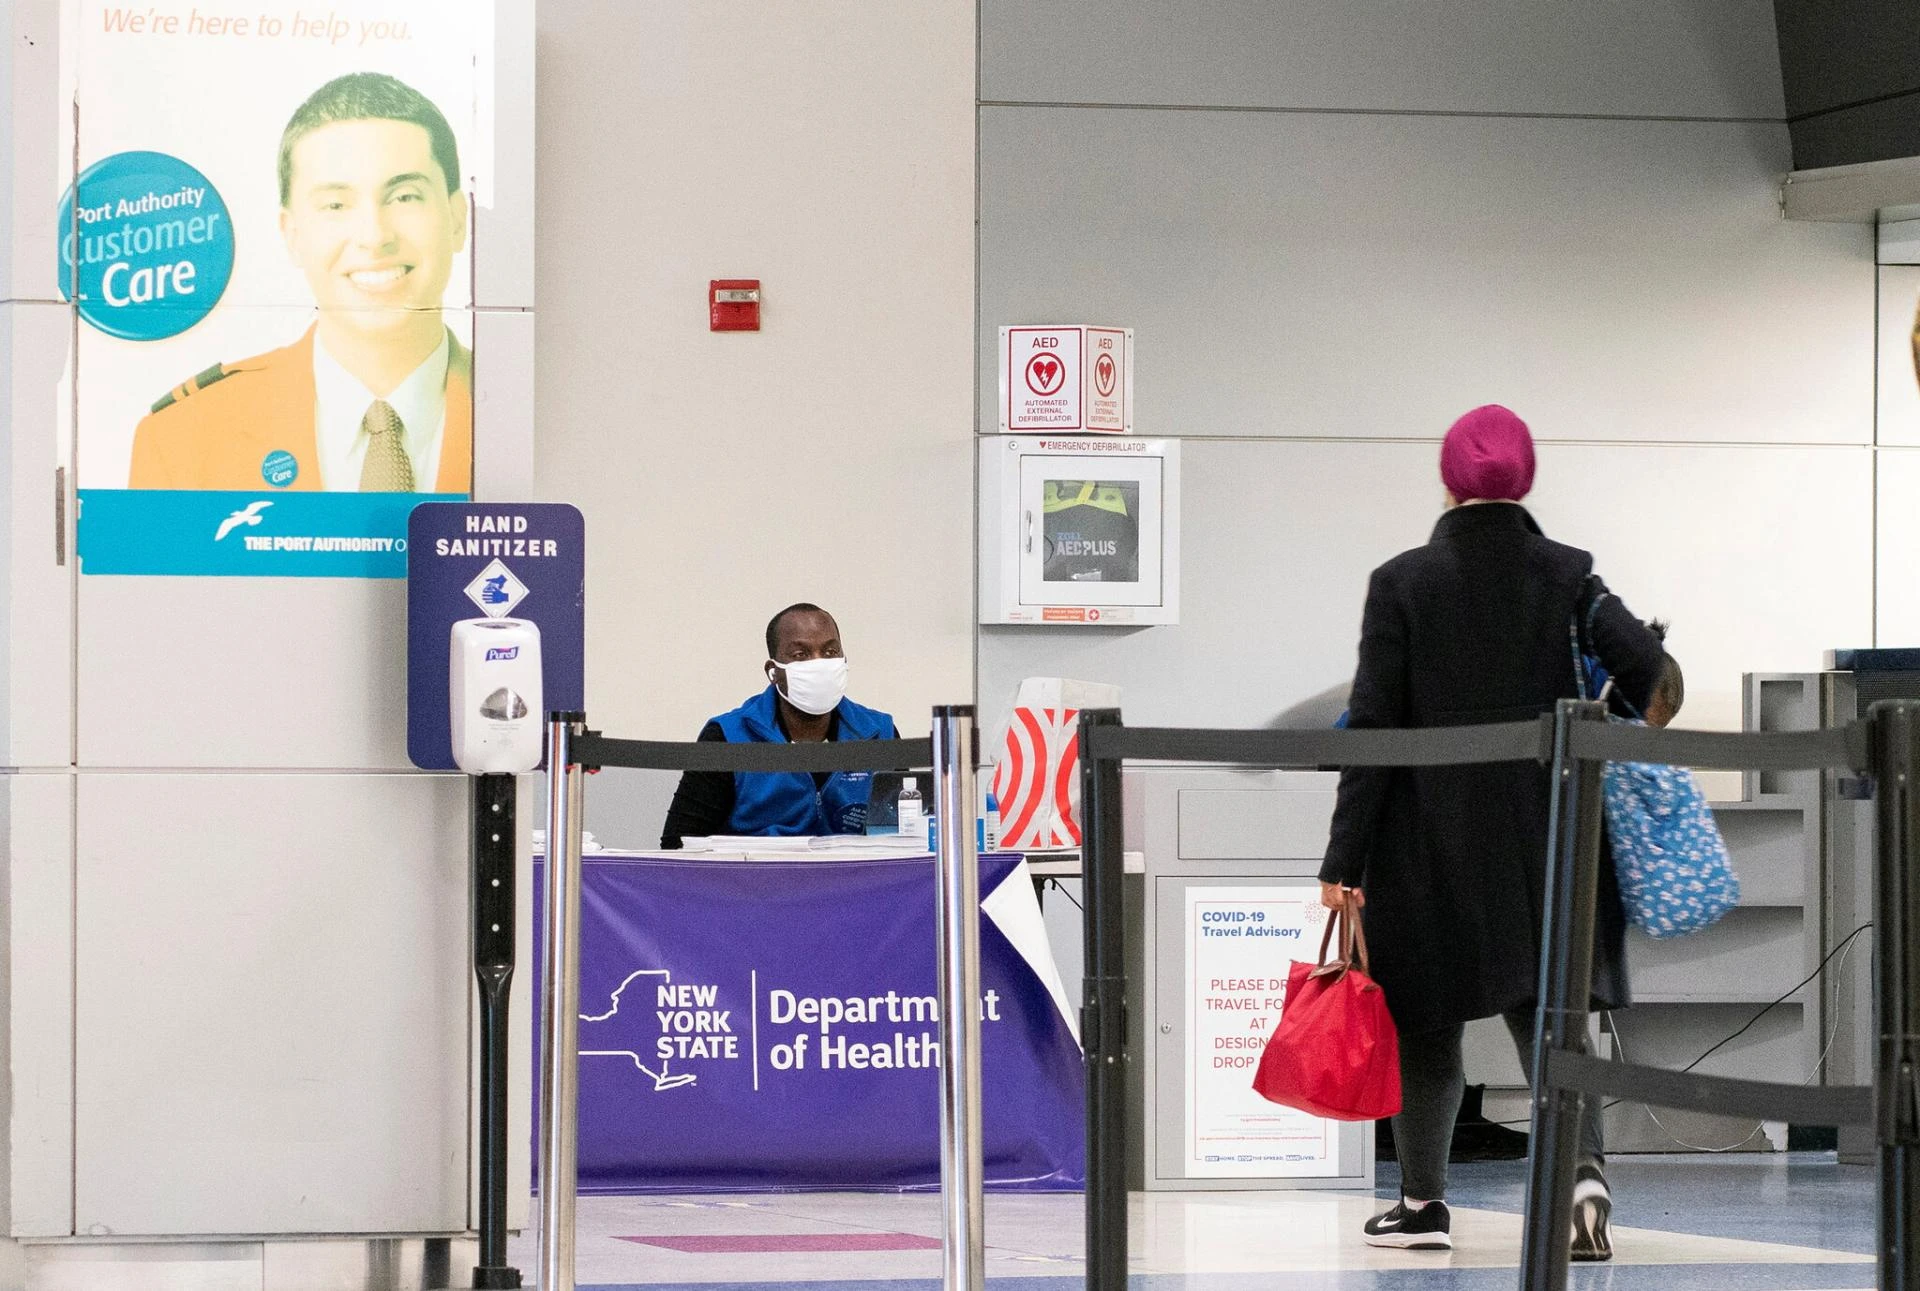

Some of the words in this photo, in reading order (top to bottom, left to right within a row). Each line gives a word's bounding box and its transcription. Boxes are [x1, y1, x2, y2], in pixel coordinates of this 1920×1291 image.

[103, 7, 179, 34] We're
[188, 8, 249, 36] here
[257, 14, 283, 37] to
[291, 11, 350, 45] help
[359, 18, 414, 46] you.
[115, 186, 206, 218] Authority
[62, 213, 220, 266] Customer
[102, 260, 196, 308] Care
[1032, 337, 1059, 348] AED
[1098, 338, 1113, 349] AED
[1047, 441, 1090, 451] EMERGENCY
[1092, 442, 1147, 452] DEFIBRILLATOR
[466, 516, 528, 533] HAND
[244, 536, 272, 551] THE
[274, 536, 313, 551] PORT
[313, 537, 393, 552] AUTHORITY
[436, 538, 558, 557] SANITIZER
[490, 648, 516, 661] Purell
[1202, 911, 1265, 923] COVID-19
[1203, 926, 1241, 937] Travel
[1245, 926, 1302, 939] Advisory
[1211, 979, 1265, 991] PLEASE
[657, 985, 719, 1008] NEW
[1206, 998, 1260, 1010] TRAVEL
[770, 989, 1001, 1034] Departmt
[657, 1010, 732, 1033] YORK
[1250, 1018, 1268, 1029] AT
[656, 1036, 739, 1060] STATE
[770, 1033, 809, 1070] of
[821, 1032, 942, 1069] Health
[1213, 1057, 1255, 1068] DROP
